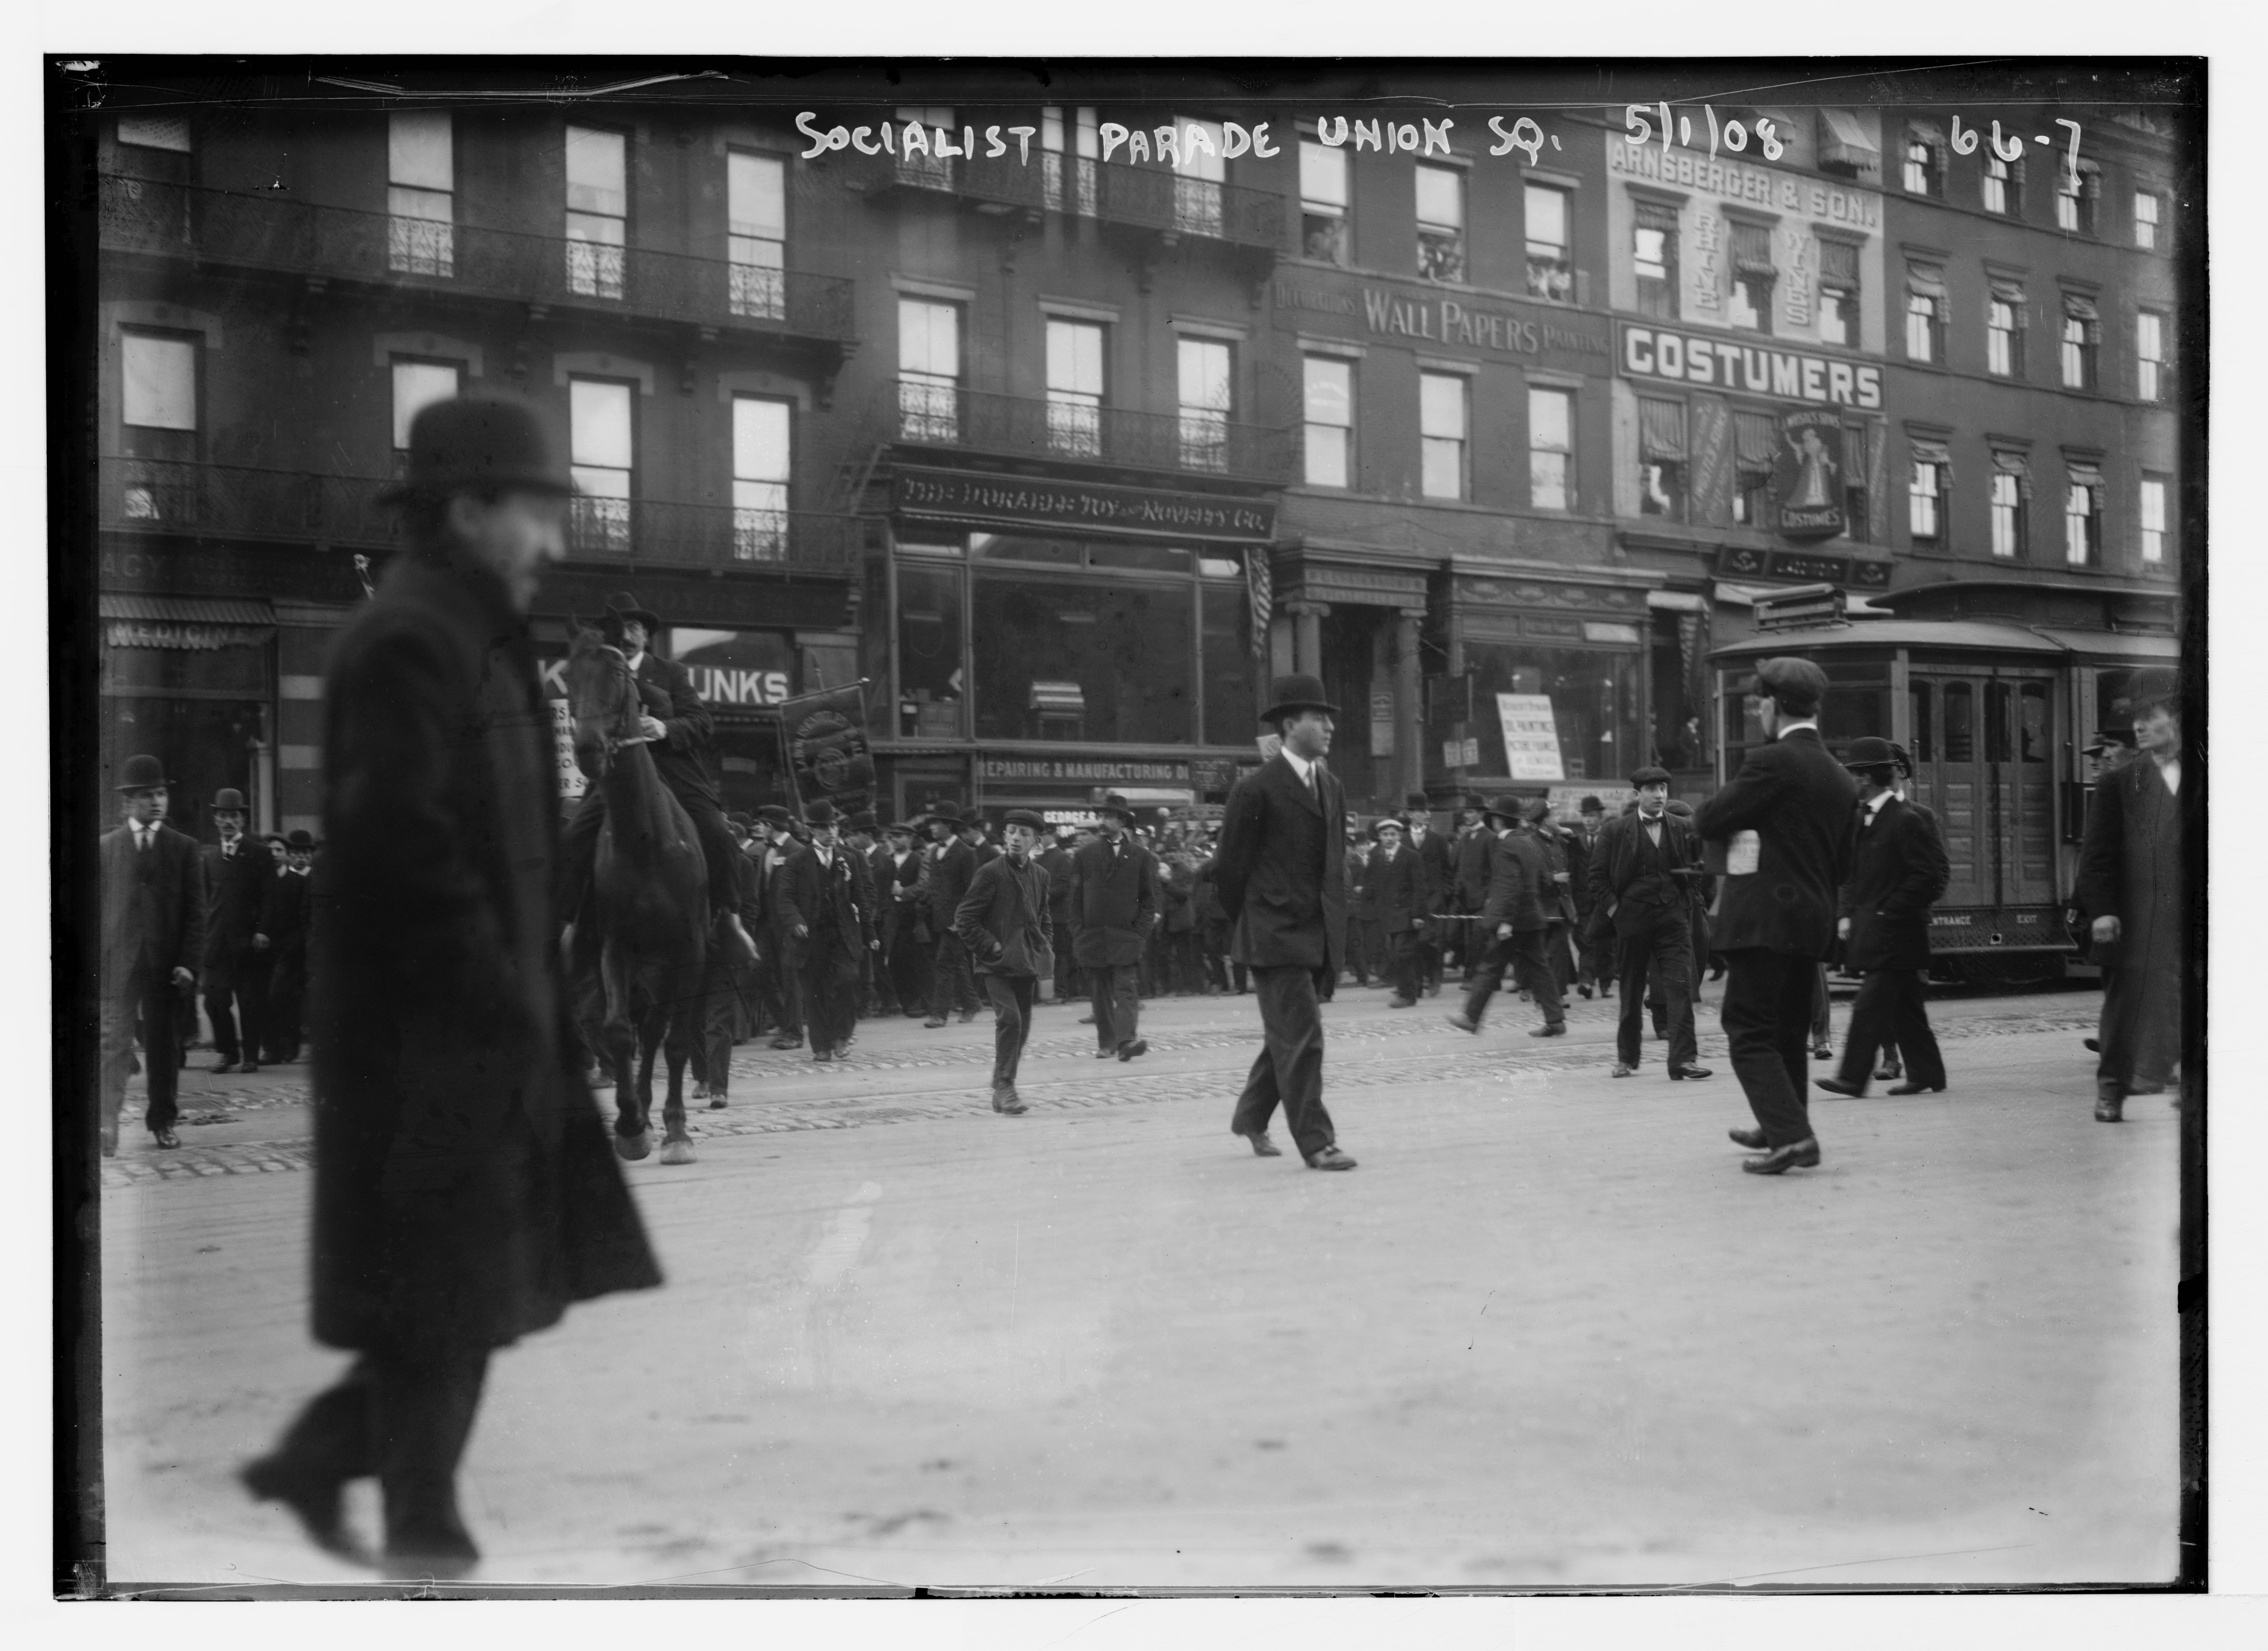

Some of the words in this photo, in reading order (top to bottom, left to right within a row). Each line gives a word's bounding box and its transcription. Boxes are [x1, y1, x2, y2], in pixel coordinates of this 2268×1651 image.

[1611, 141, 1773, 206] ARNSBERGER
[1782, 180, 1801, 211] &
[1364, 288, 1436, 339] WALL
[1441, 300, 1538, 354] PAPERS
[1626, 327, 1880, 409] COSTUMERS
[687, 667, 789, 704] UNKS
[977, 760, 1050, 777] REPAIRING
[1054, 762, 1063, 778] &
[1066, 763, 1172, 780] MANUFACTURING
[1929, 915, 1972, 926] NTRANCE
